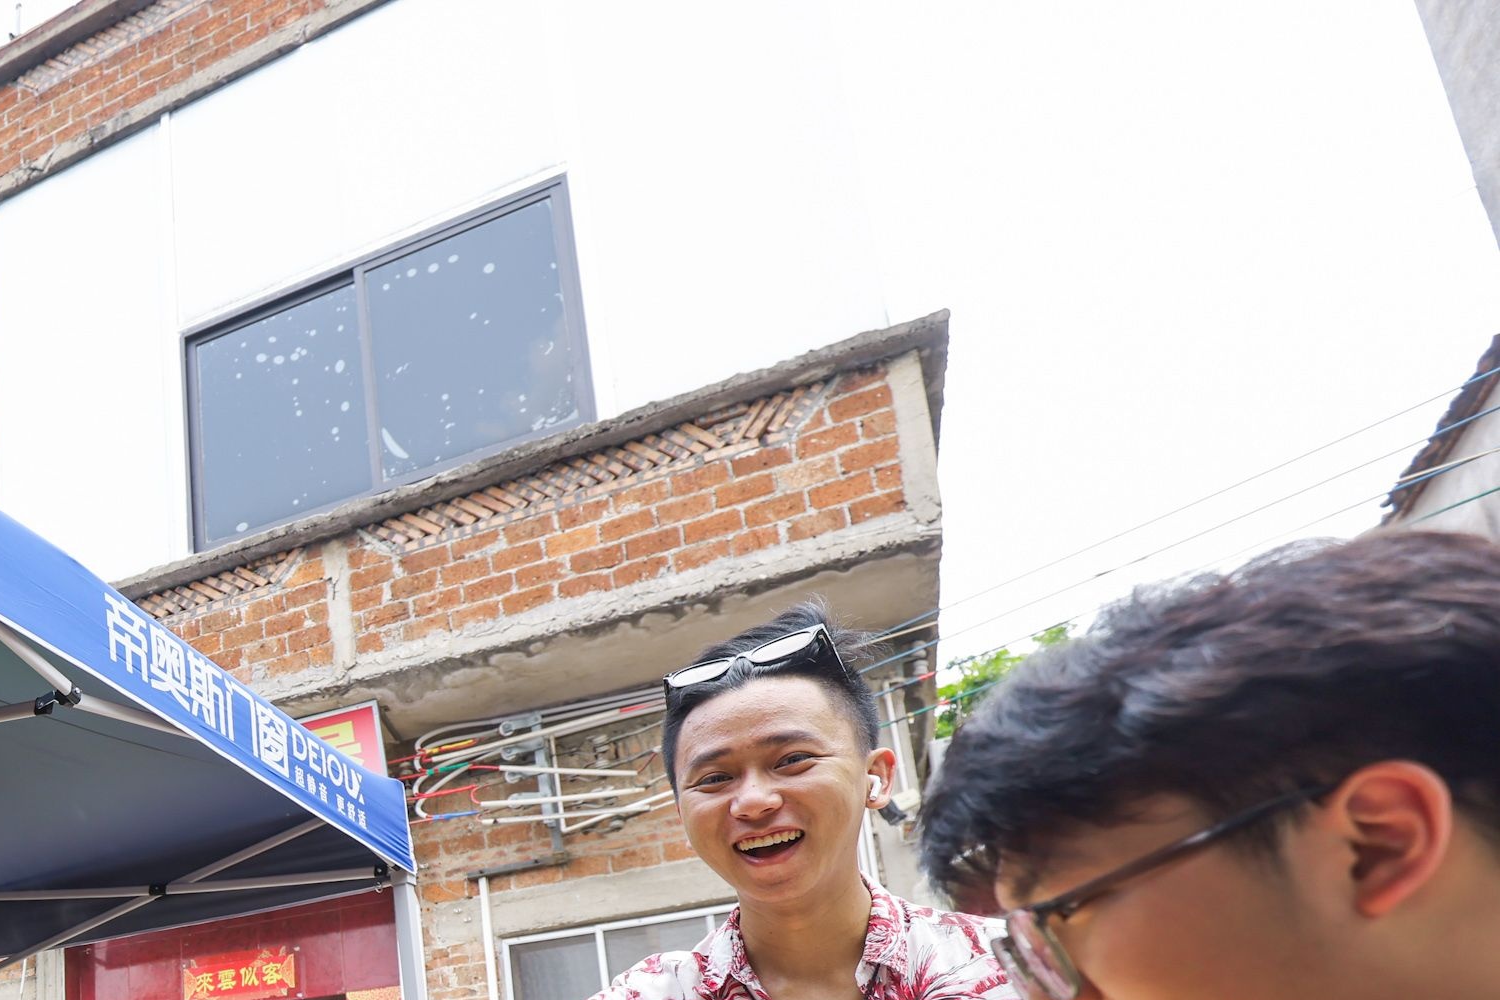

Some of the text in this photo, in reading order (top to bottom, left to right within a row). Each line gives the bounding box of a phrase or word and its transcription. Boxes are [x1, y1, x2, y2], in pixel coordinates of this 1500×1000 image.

[105, 592, 289, 778] 帝奥斯门窗
[295, 764, 368, 830] 超静音 更舒适
